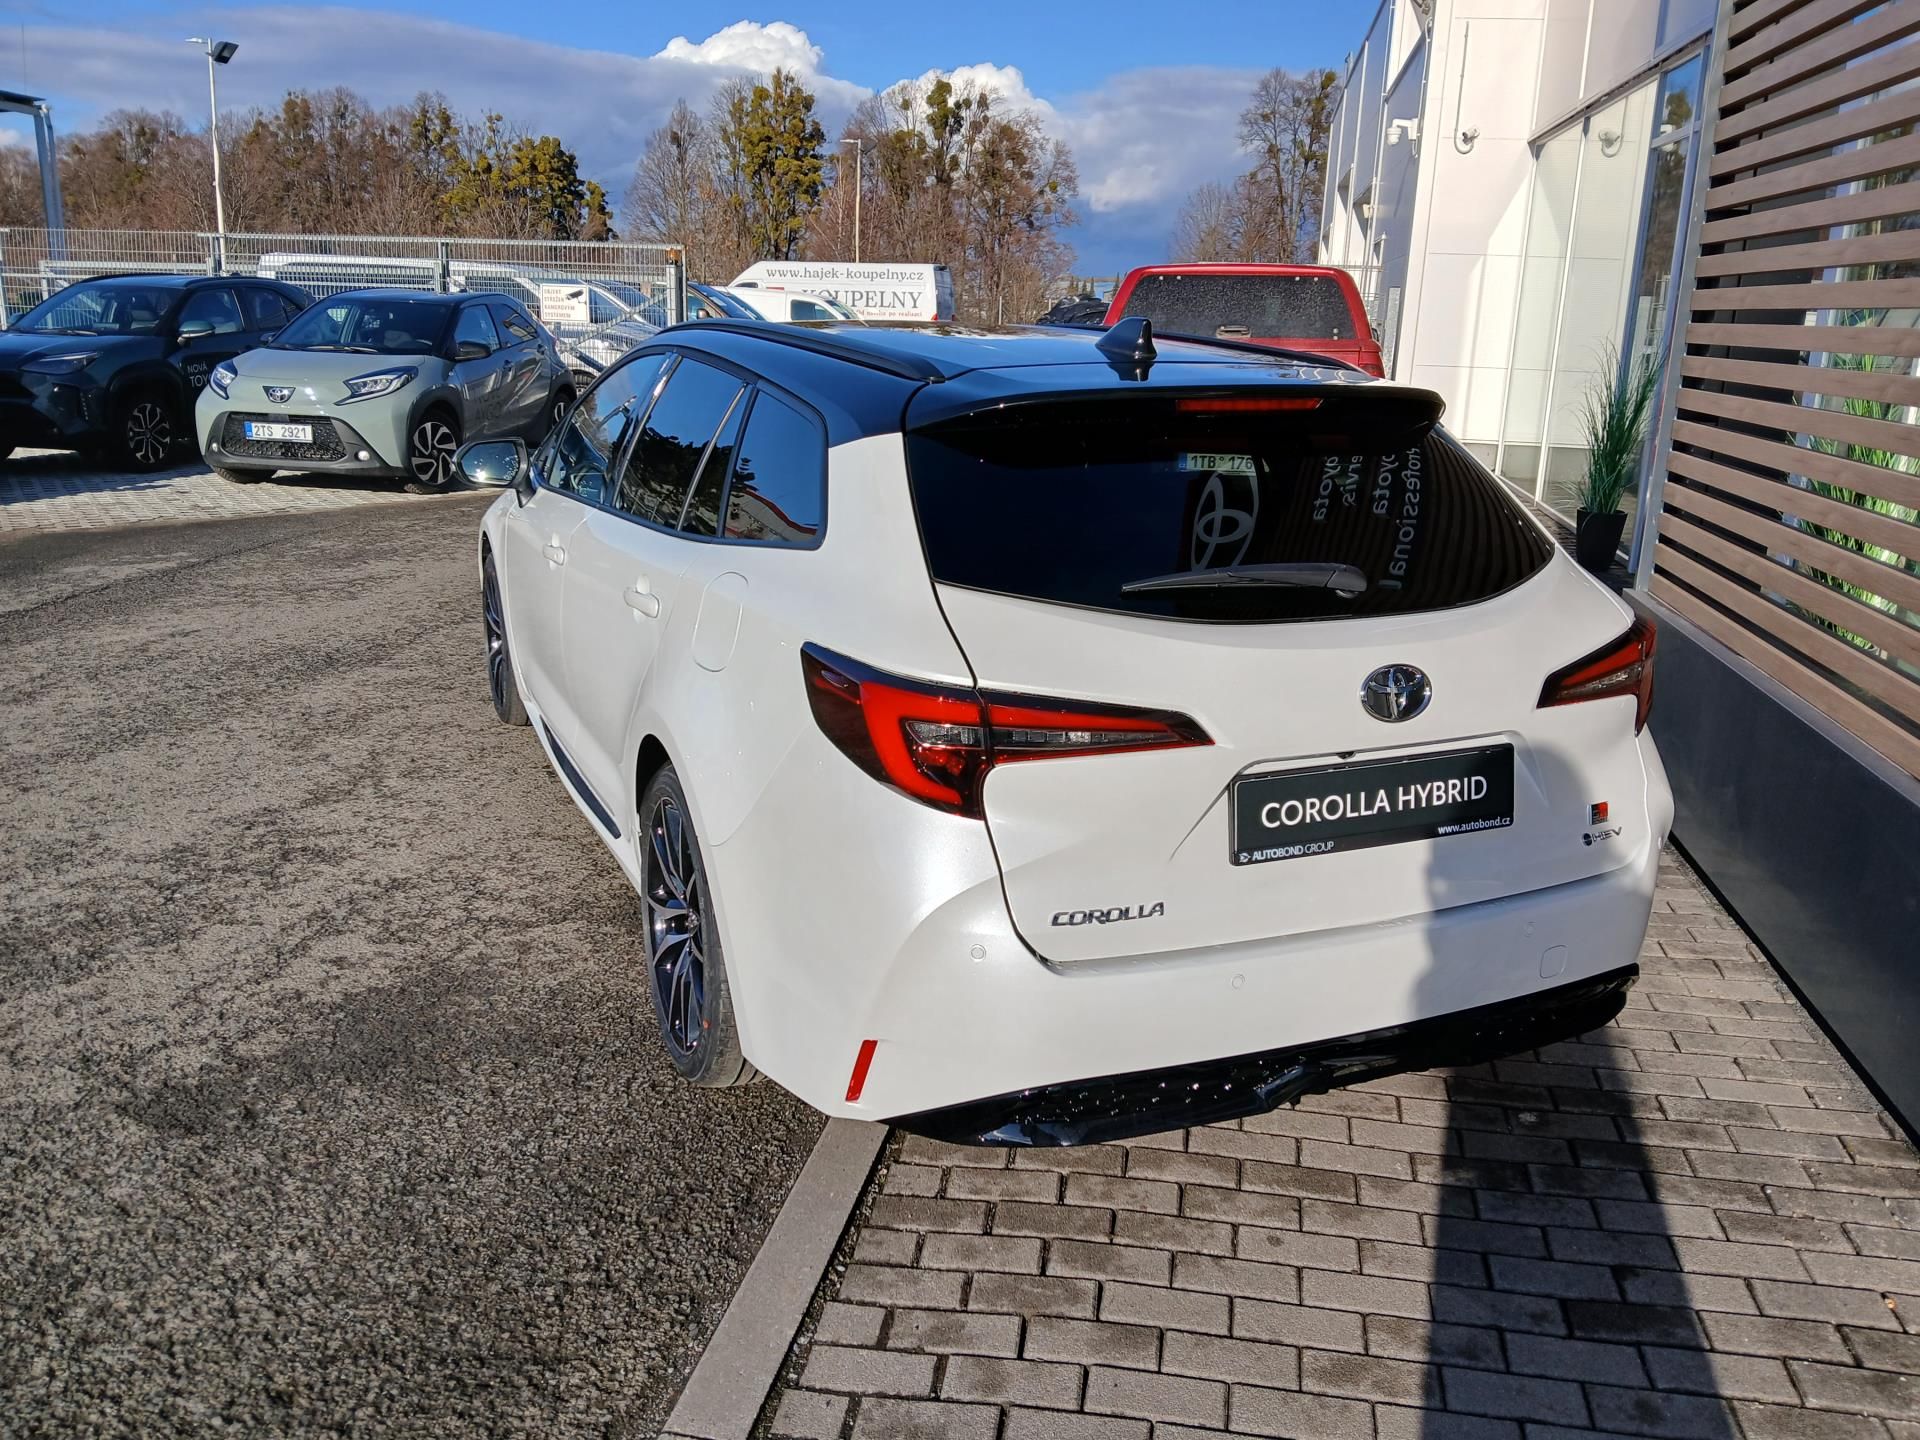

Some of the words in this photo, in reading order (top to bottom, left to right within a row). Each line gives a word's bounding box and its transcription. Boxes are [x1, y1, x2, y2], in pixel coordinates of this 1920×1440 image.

[766, 266, 924, 282] www.hajek-koupelny.cz
[189, 374, 208, 387] TOY
[254, 425, 274, 437] 2TS
[280, 427, 307, 438] 2921
[1191, 456, 1216, 469] 1TB
[1229, 457, 1254, 470] 176
[1261, 789, 1391, 829] COROLLA
[1397, 775, 1488, 811] HYBRID
[1437, 816, 1511, 835] www.autobond.cz
[1252, 845, 1304, 862] AUTOBOND
[1305, 840, 1335, 855] GROUP
[1051, 901, 1165, 926] COROLLA
